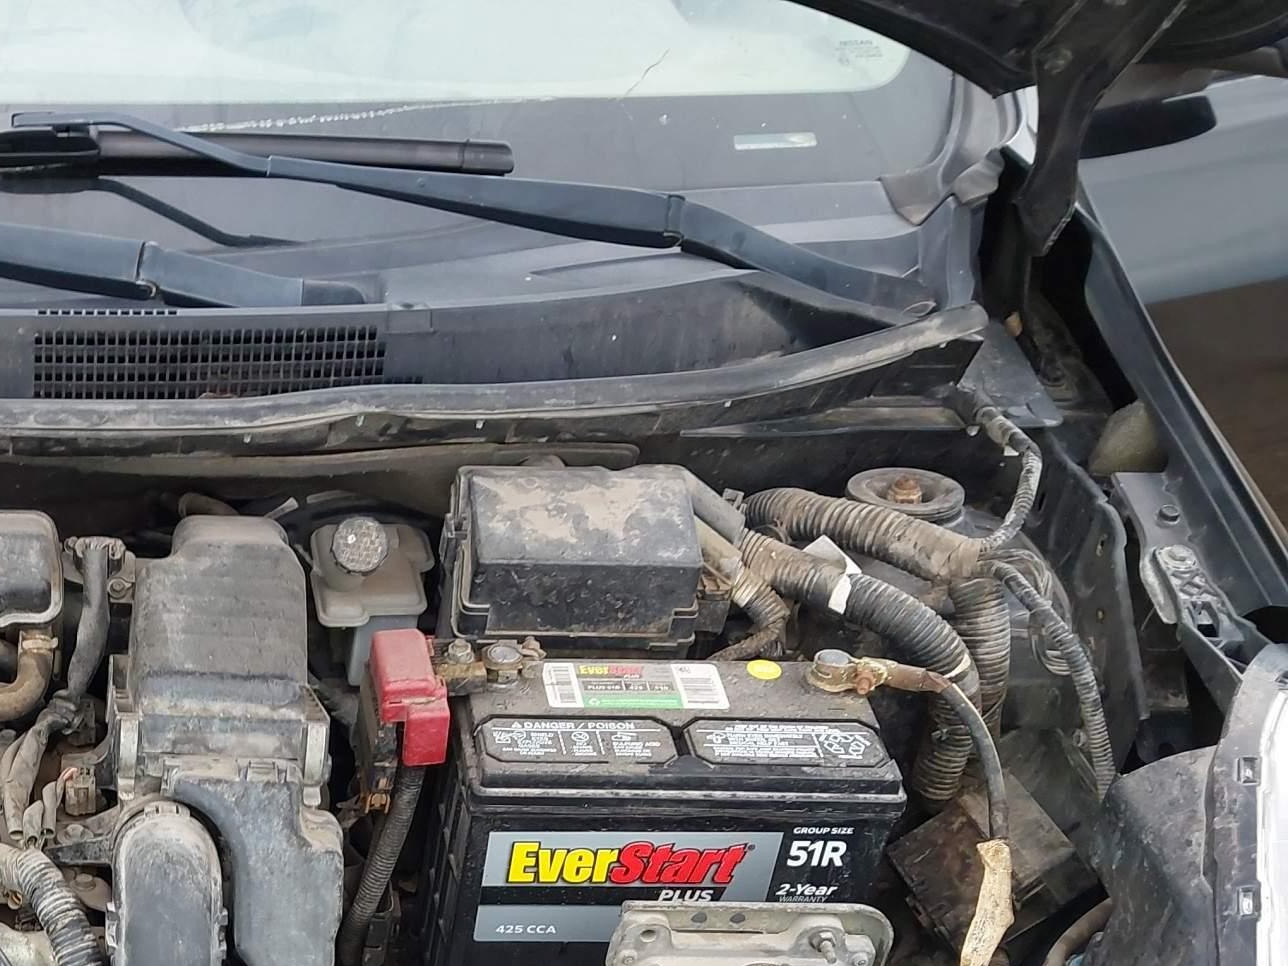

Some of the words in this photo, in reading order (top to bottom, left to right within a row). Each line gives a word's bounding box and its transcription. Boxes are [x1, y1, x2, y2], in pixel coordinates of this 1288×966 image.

[524, 722, 575, 730] DANGER
[587, 722, 635, 730] POISON
[793, 827, 830, 835] GROUP
[831, 827, 855, 835] SIZE
[786, 840, 847, 867] 51R
[507, 841, 747, 884] EverStart
[775, 883, 839, 895] 2-Year
[657, 889, 714, 902] PLUS
[778, 894, 829, 903] WARRANTY
[495, 925, 524, 934] 425
[526, 925, 557, 934] CCA
